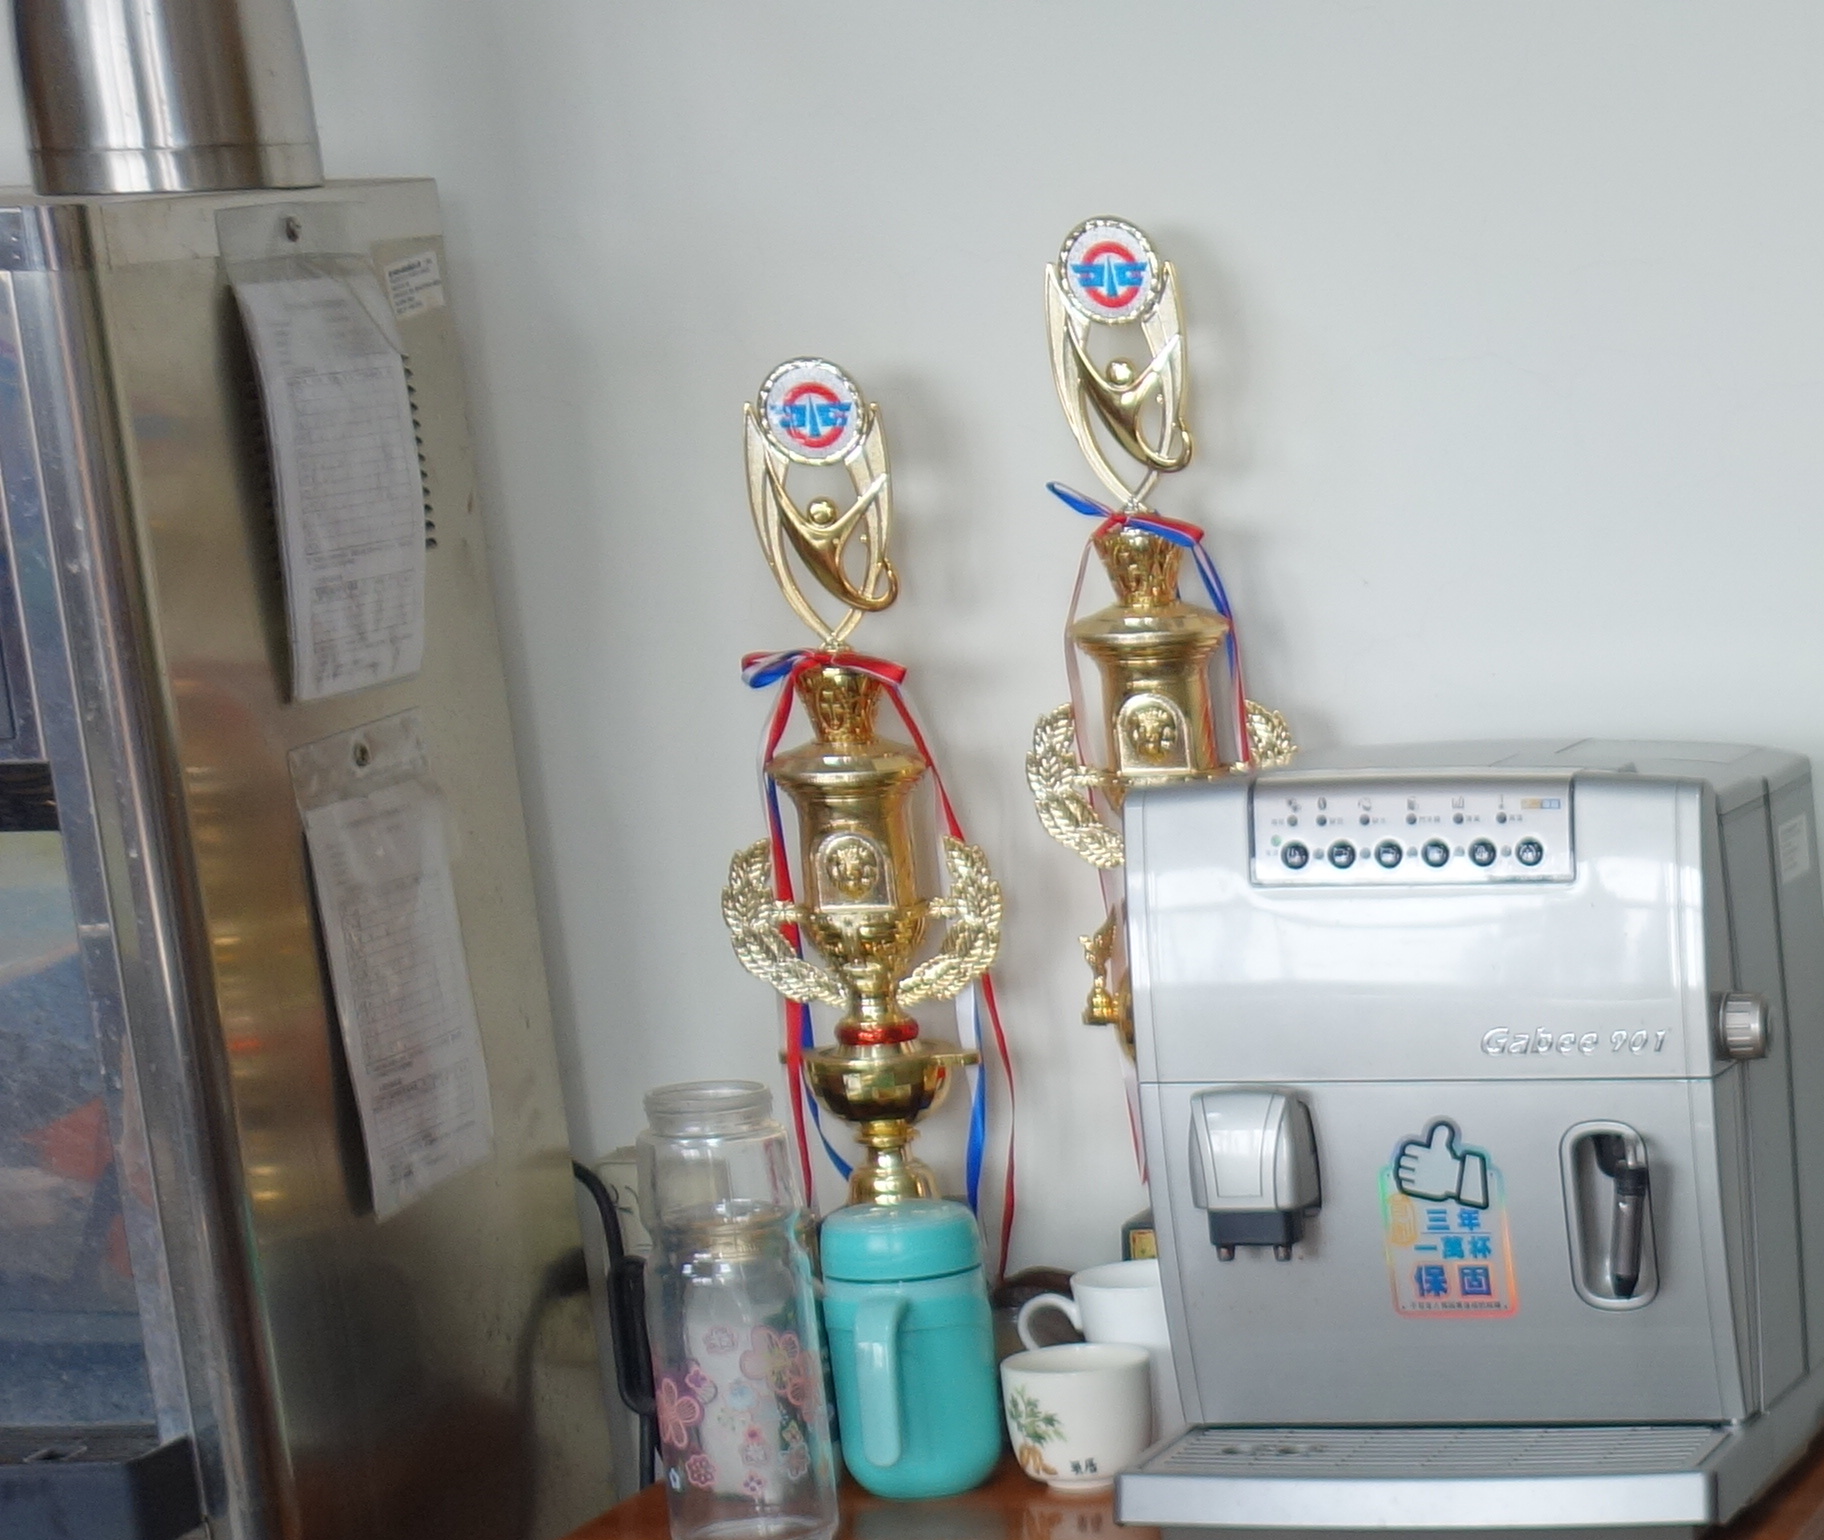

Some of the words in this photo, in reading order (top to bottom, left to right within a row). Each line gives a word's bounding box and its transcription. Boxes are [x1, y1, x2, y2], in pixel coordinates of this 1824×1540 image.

[1481, 1026, 1599, 1057] Gabee
[1609, 1029, 1667, 1055] 901
[1426, 1208, 1481, 1231] 三年
[1414, 1236, 1492, 1259] 一萬杯
[1414, 1265, 1492, 1297] 保固
